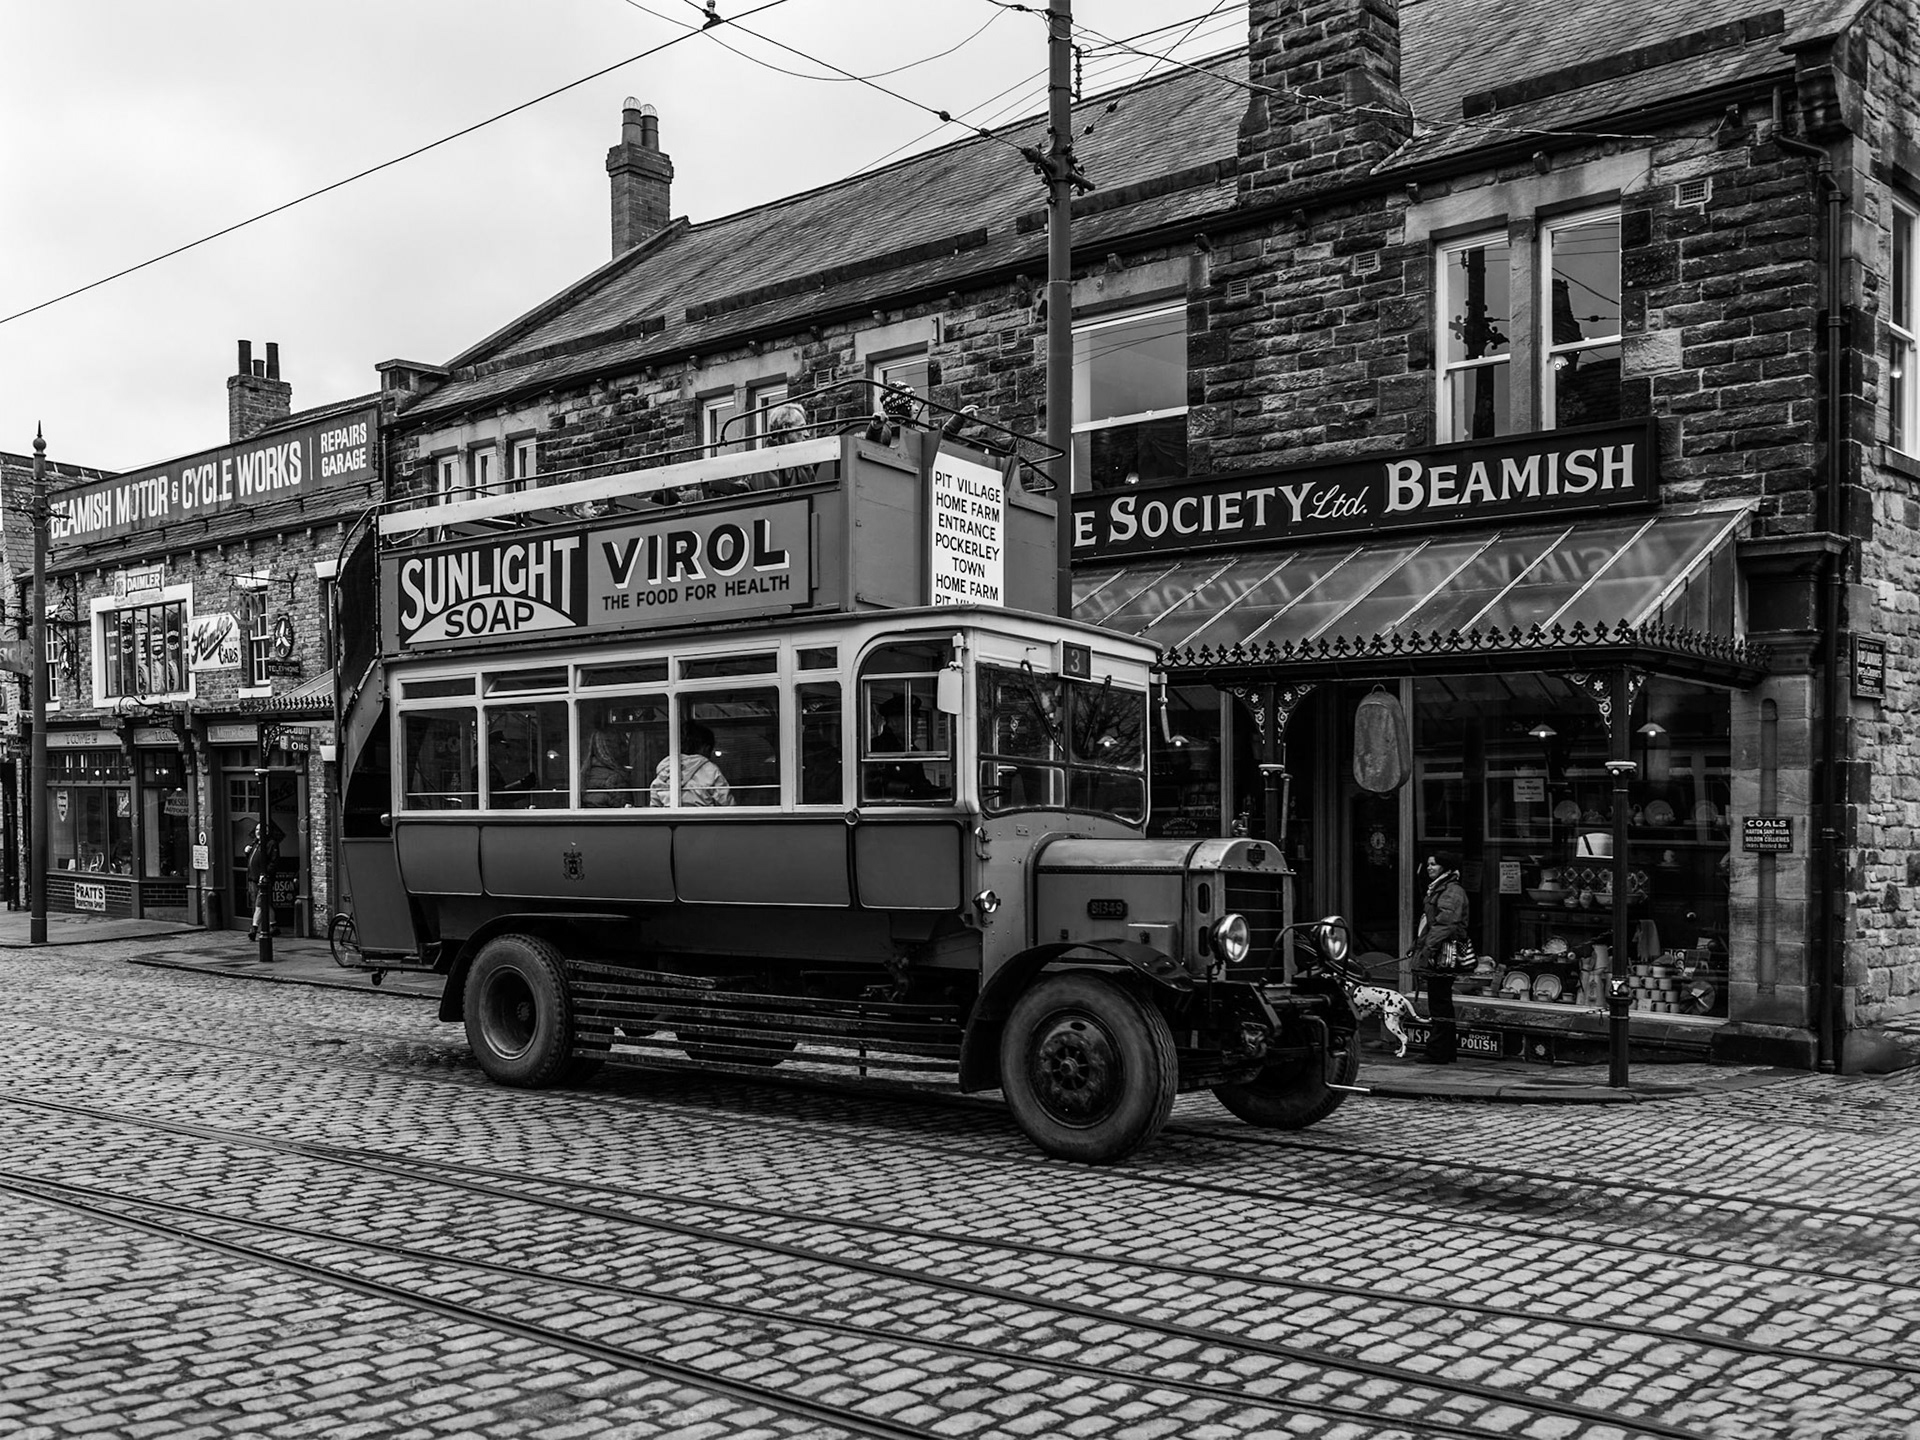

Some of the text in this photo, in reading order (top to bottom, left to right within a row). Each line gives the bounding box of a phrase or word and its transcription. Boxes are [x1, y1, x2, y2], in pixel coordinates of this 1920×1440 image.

[320, 422, 367, 454] REPAIRS
[321, 447, 367, 478] GARAGE
[51, 492, 112, 539] BEAMISH
[116, 476, 169, 526] MOTOR
[182, 459, 233, 510] CYCLE
[236, 441, 302, 497] WORKS
[935, 471, 1001, 504] PIT VILLAGE
[1108, 482, 1317, 543] SOCIETY
[1307, 485, 1368, 519] Ltd.
[1385, 444, 1636, 514] BEAMISH
[936, 491, 1000, 523] HOME FARM
[938, 512, 996, 541] ENTRANCE
[602, 518, 790, 590] VIROL
[935, 532, 1001, 561] POCKERLEY
[127, 573, 161, 592] DAIMLER
[952, 557, 985, 578] TOWN
[401, 536, 580, 631] SUNLIGHT
[602, 574, 790, 611] THE FOOD FOR HEALTH
[936, 573, 999, 601] HOME FARM
[444, 602, 535, 638] SOAP
[1071, 649, 1081, 673] 3
[290, 742, 309, 751] Oils
[1460, 1037, 1498, 1052] POLISH
